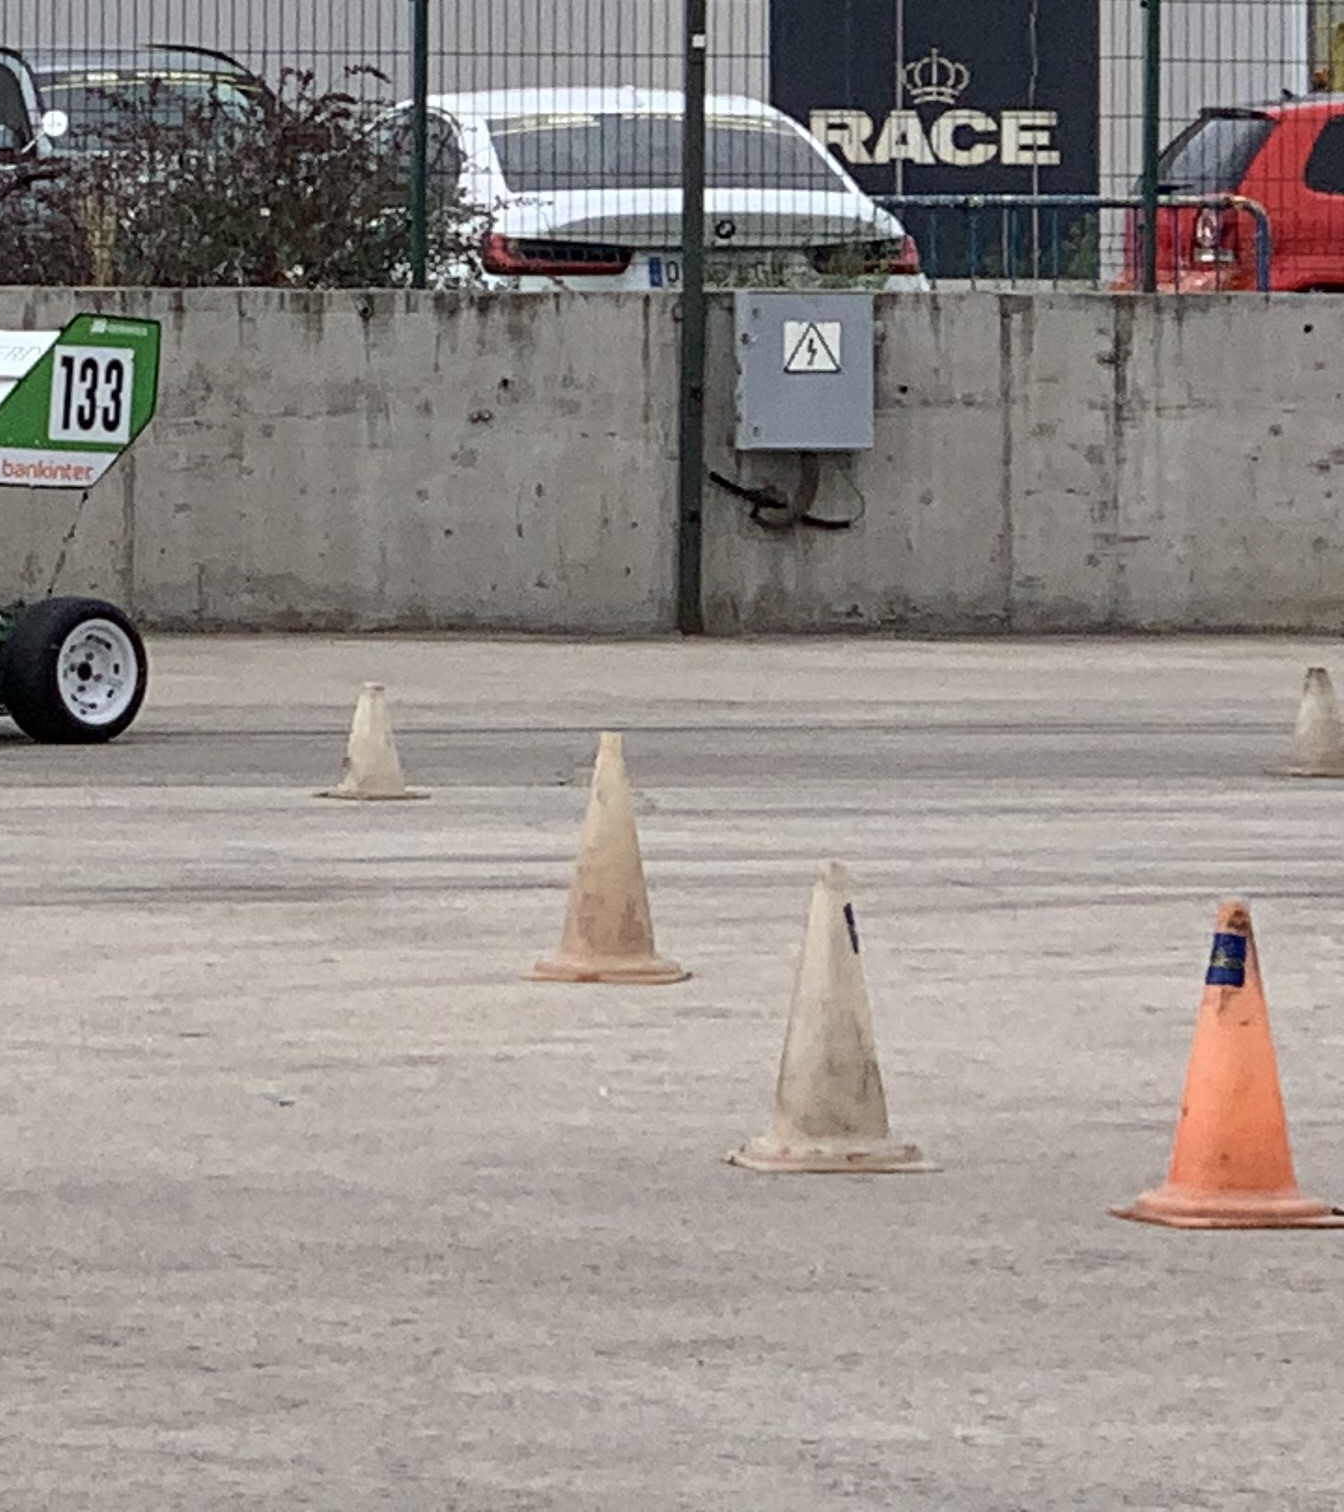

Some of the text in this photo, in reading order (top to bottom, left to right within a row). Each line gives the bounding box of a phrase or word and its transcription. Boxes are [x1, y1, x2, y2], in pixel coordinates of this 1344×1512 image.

[810, 109, 1060, 166] RACE
[60, 355, 125, 432] 133
[1, 458, 94, 481] bankinter
